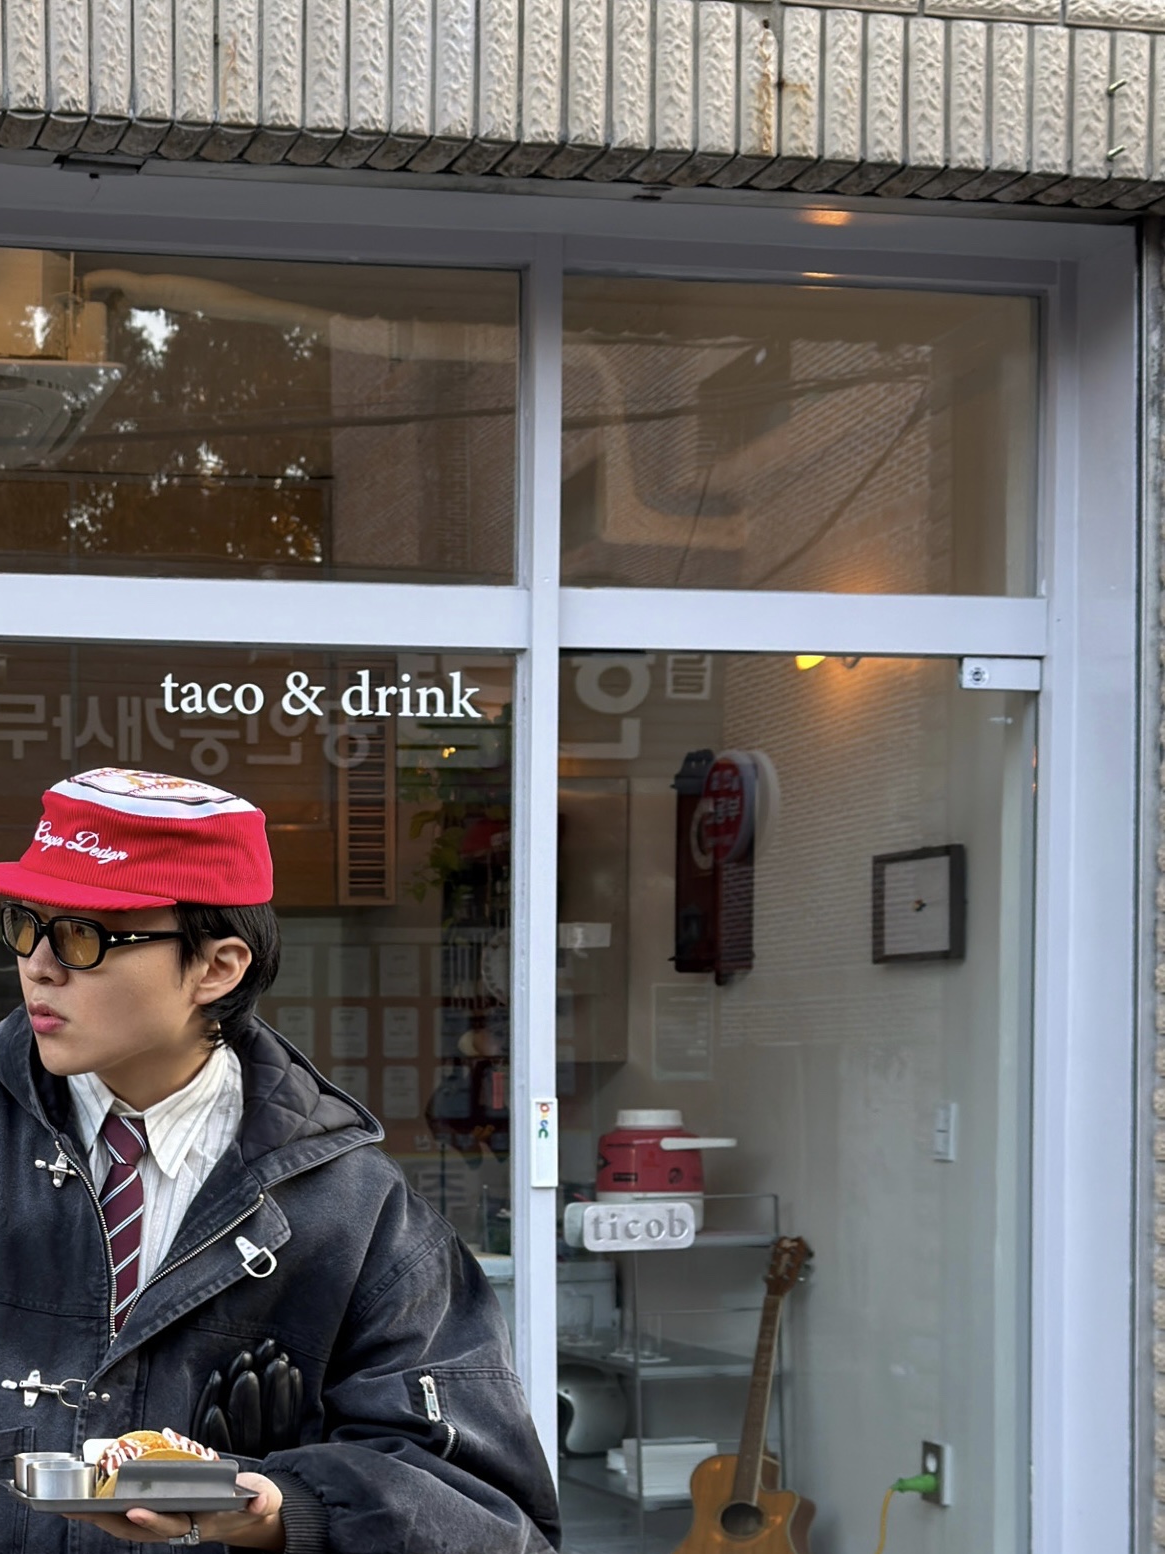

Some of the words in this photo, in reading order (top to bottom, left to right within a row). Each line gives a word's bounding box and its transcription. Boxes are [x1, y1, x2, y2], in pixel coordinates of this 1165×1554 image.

[160, 673, 264, 715] taco
[281, 671, 326, 716] &
[341, 669, 482, 718] drink
[65, 831, 128, 865] Design
[591, 1208, 689, 1242] ticob
